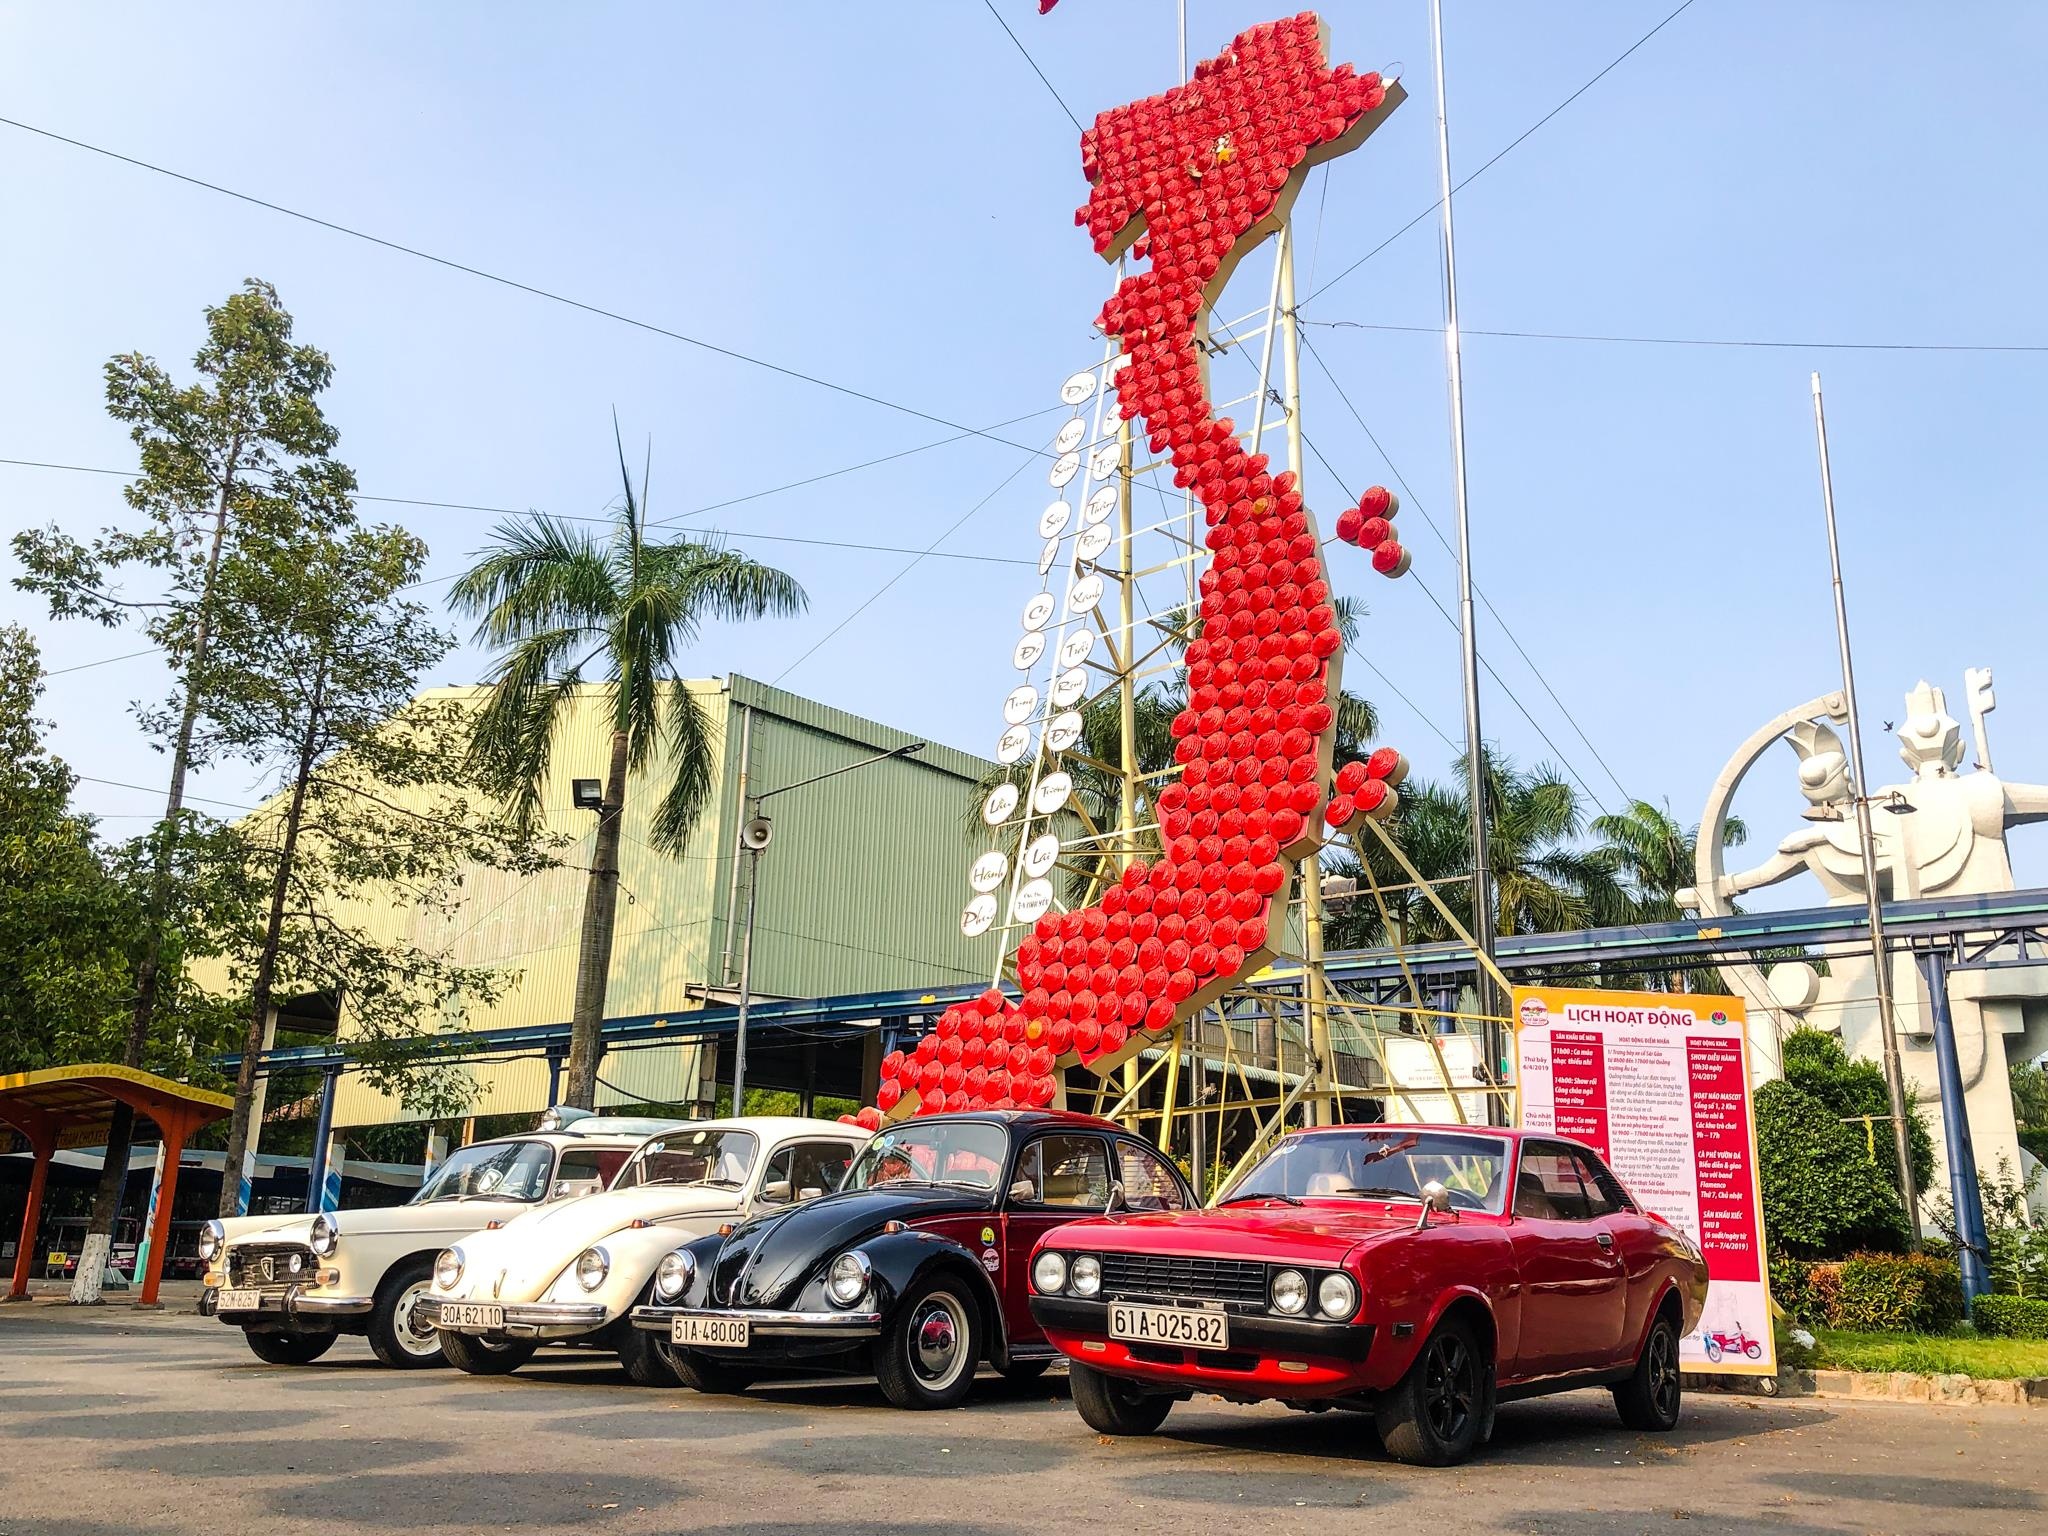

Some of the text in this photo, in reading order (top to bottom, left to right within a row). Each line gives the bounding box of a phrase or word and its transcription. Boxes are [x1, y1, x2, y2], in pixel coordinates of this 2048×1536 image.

[1568, 1009, 1692, 1028] LỊCH HOẠT ĐỘNG
[1721, 1054, 1736, 1062] HÀNH
[1709, 1064, 1723, 1072] ngày
[1693, 1092, 1708, 1101] HOẠT
[1708, 1092, 1720, 1100] NÁO
[1694, 1102, 1708, 1110] Cổng
[220, 1291, 258, 1307] 52M-8257
[443, 1306, 500, 1325] 30A-621.10
[675, 1320, 745, 1342] 51A-480.08
[1115, 1309, 1222, 1343] 61A-025.82
